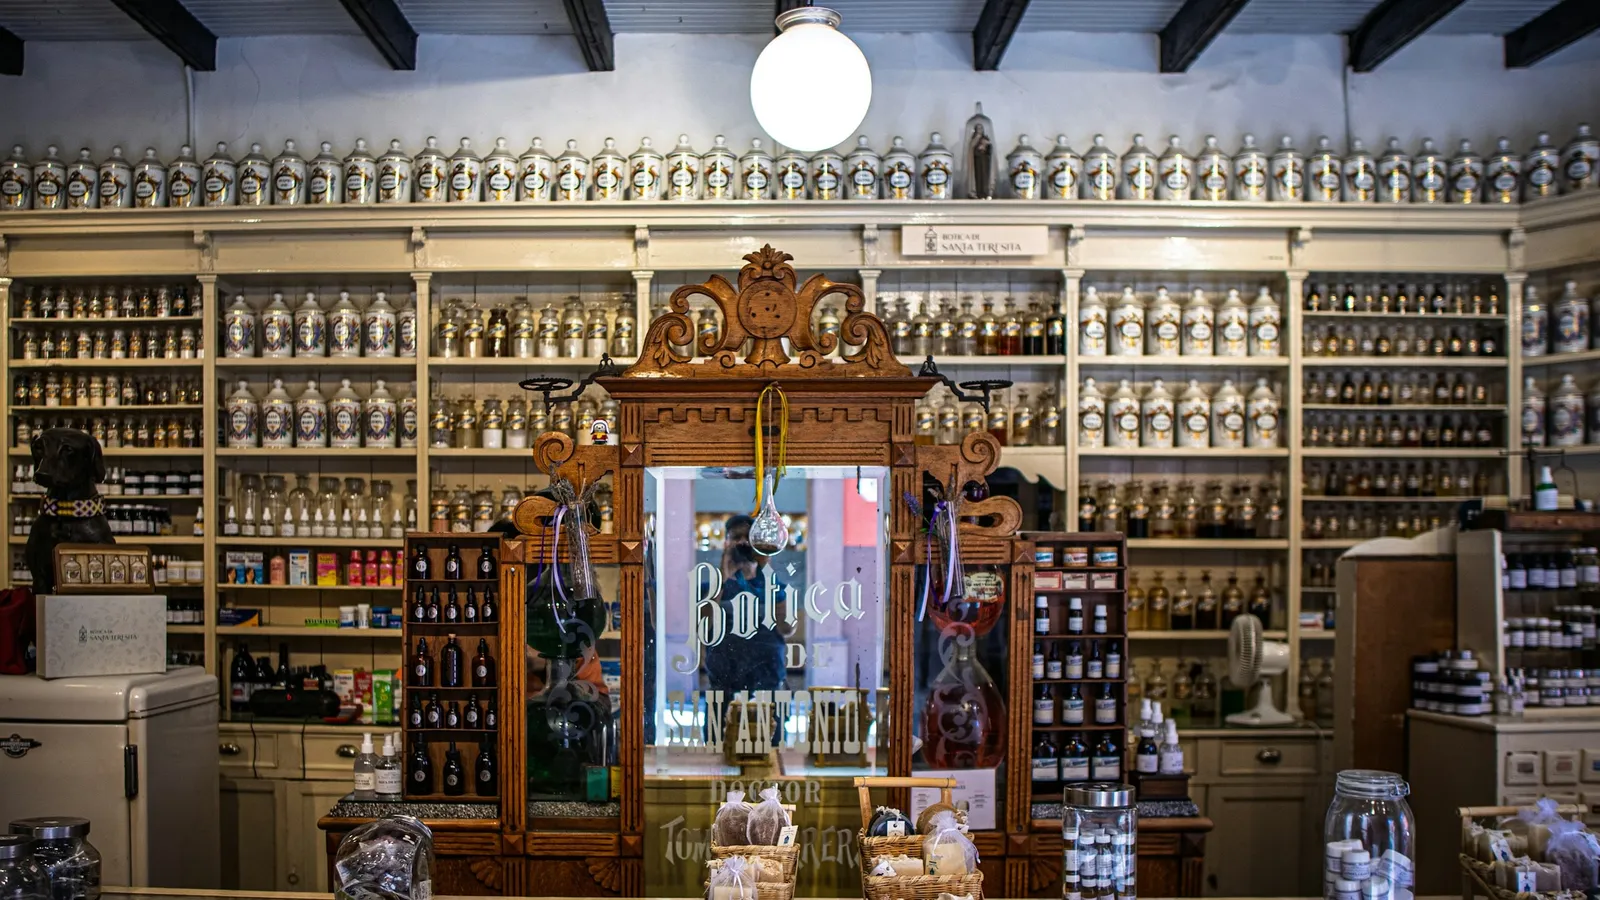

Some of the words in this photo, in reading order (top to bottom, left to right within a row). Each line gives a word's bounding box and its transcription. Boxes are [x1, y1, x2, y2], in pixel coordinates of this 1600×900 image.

[941, 243, 974, 253] SANTA
[977, 243, 1022, 253] TERESITA
[671, 562, 866, 675] Botica
[90, 634, 110, 642] SANTA
[785, 643, 831, 669] DE
[668, 690, 724, 754] SAN
[710, 780, 821, 804] DOCOR
